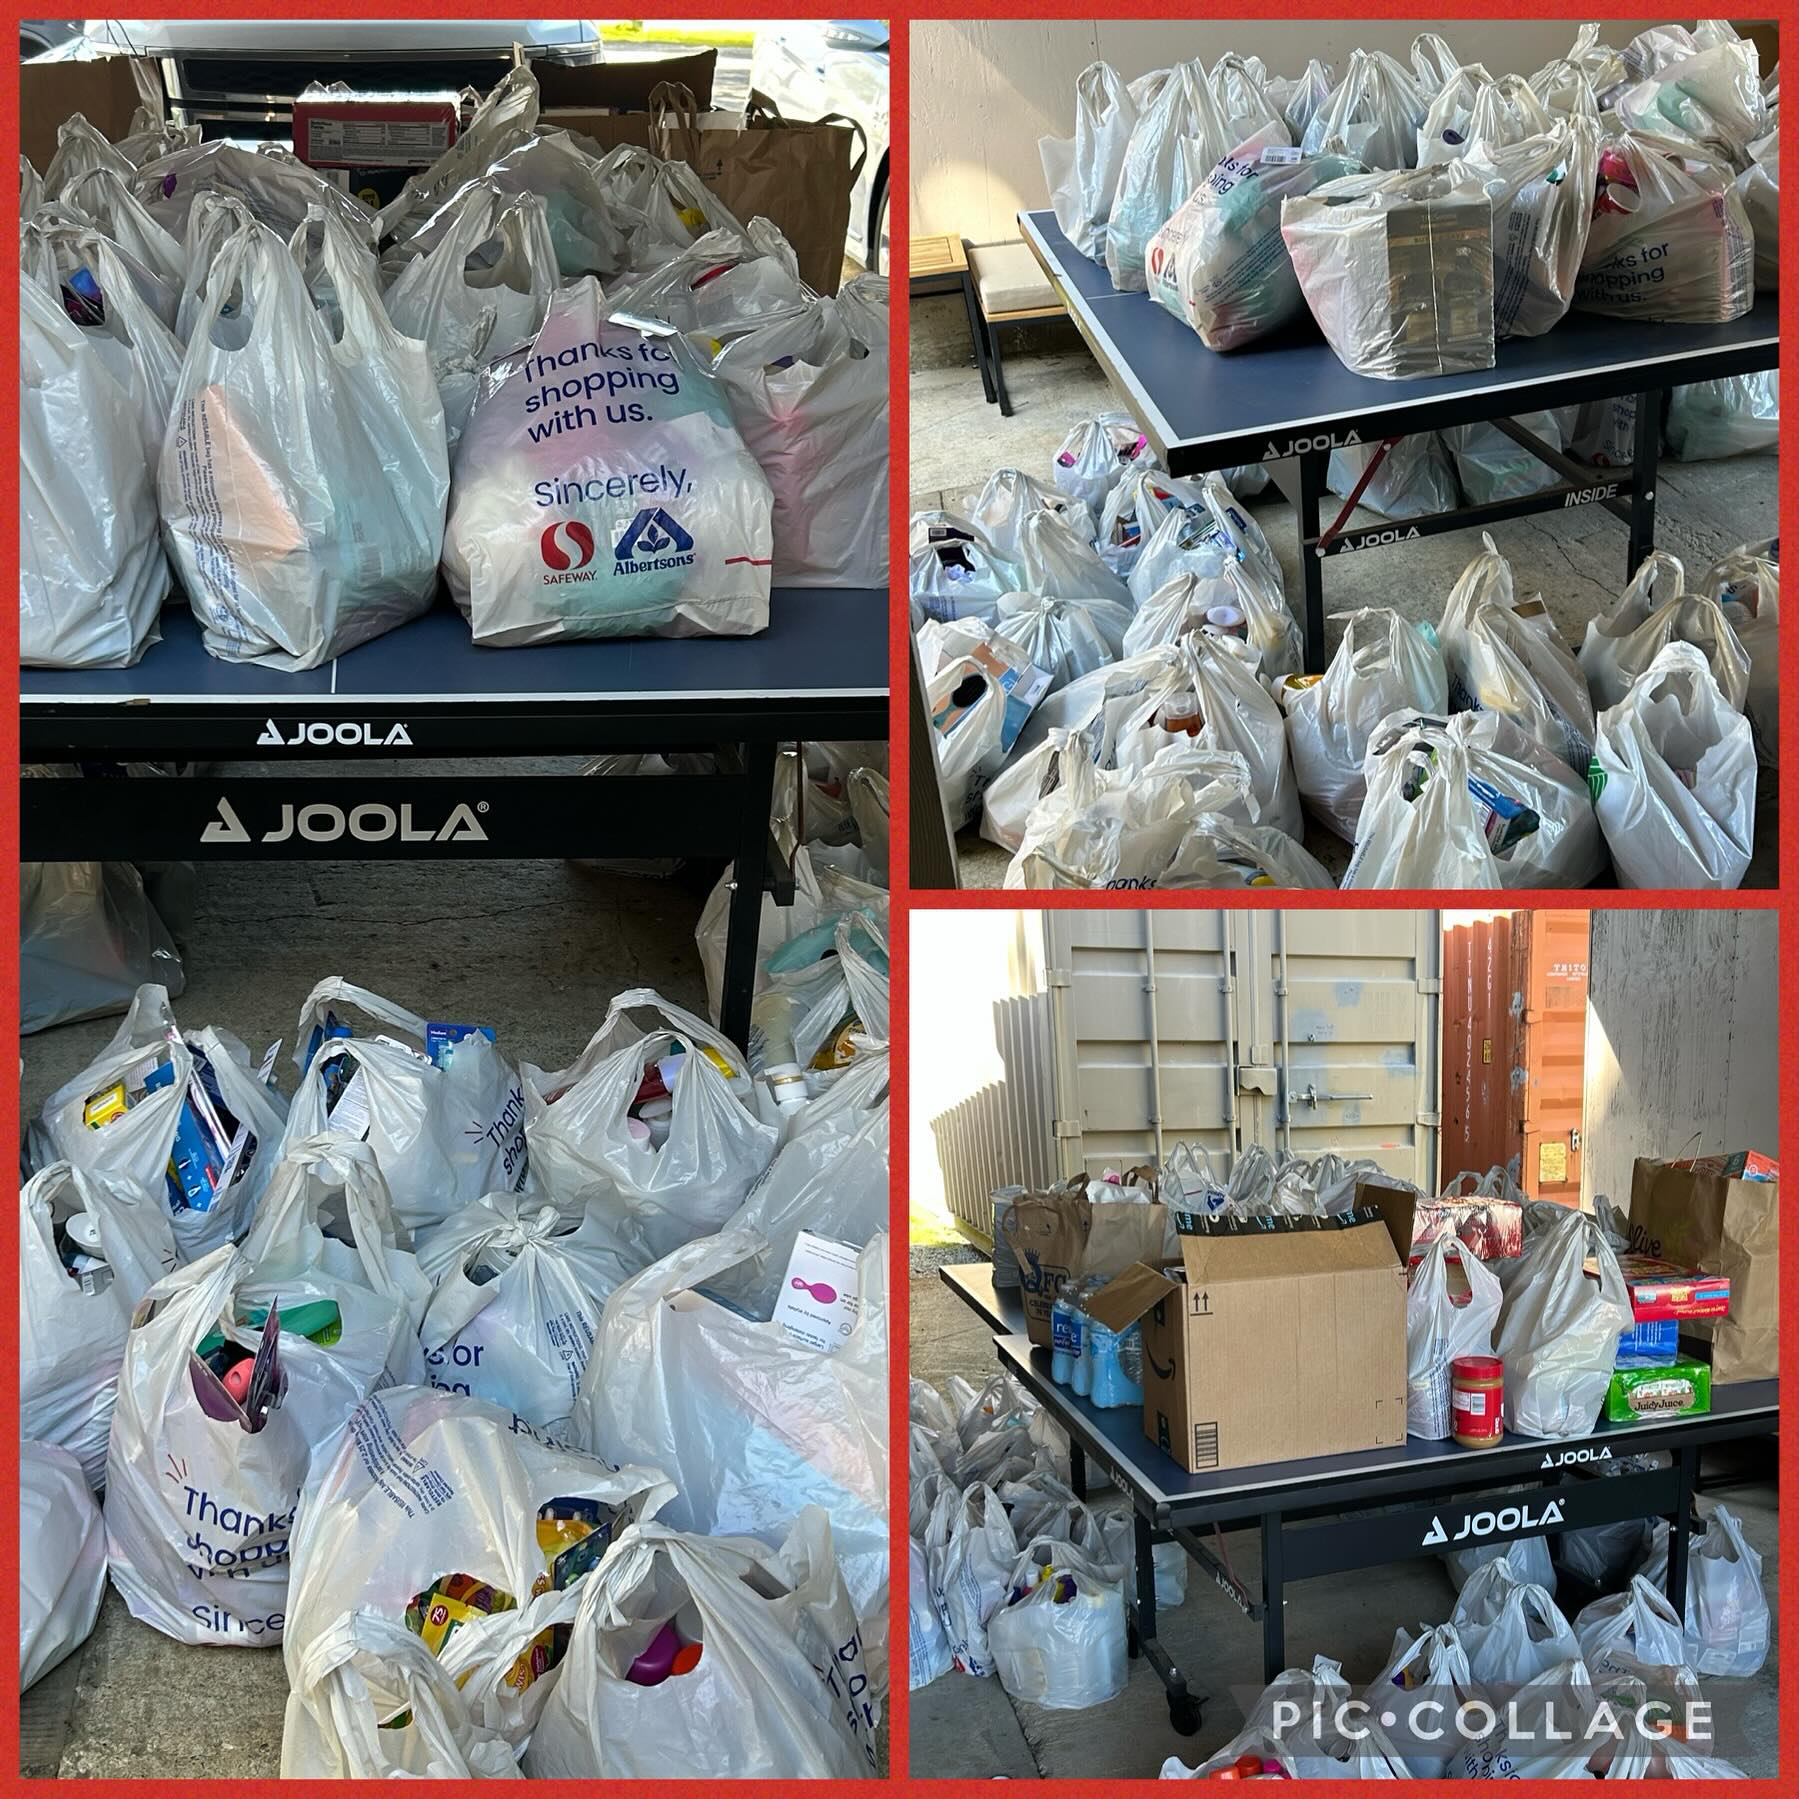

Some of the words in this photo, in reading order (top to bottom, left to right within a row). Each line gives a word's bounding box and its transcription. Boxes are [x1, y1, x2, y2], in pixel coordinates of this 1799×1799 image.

[1641, 243, 1669, 262] for
[525, 341, 634, 383] Thanks
[638, 343, 672, 363] fo
[525, 367, 680, 413] shopping
[528, 404, 597, 443] with
[606, 403, 653, 424] us.
[1282, 429, 1362, 457] JOOLA
[534, 465, 692, 507] Sincerely,
[1564, 483, 1618, 508] INSIDE
[1356, 525, 1421, 550] JOOLA
[543, 569, 598, 585] SAFEWAY
[613, 553, 695, 576] Albertsons
[287, 722, 414, 746] JOOLA
[1553, 963, 1587, 972] TRITO
[485, 1084, 525, 1149] Thank
[1554, 1446, 1613, 1467] JOOLA
